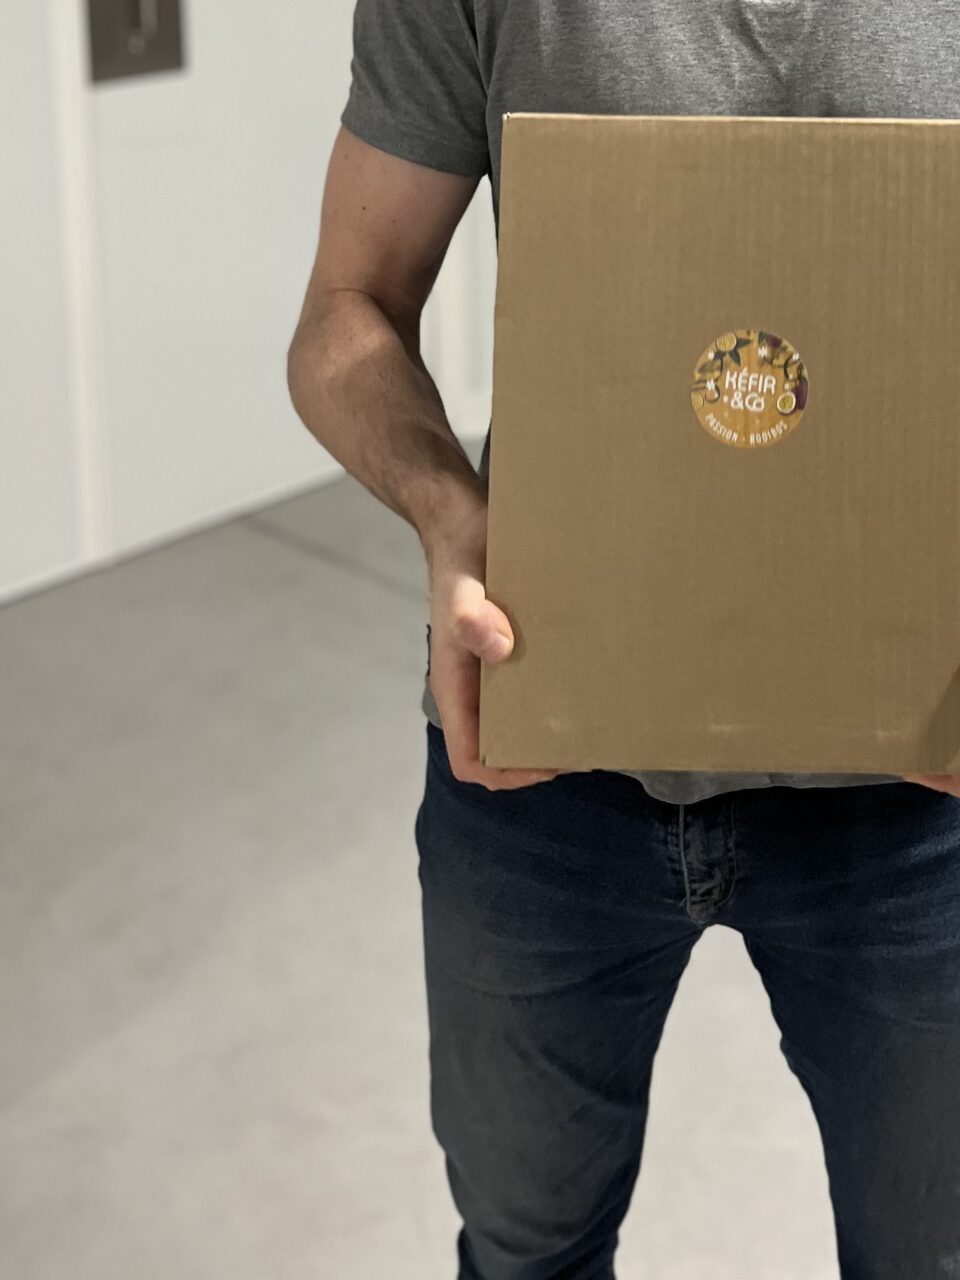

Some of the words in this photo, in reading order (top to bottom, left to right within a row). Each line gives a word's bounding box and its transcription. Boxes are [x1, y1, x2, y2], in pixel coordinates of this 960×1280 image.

[725, 368, 776, 394] KÉFIR
[705, 413, 738, 441] PASSION
[750, 420, 788, 445] ROOIBOS
